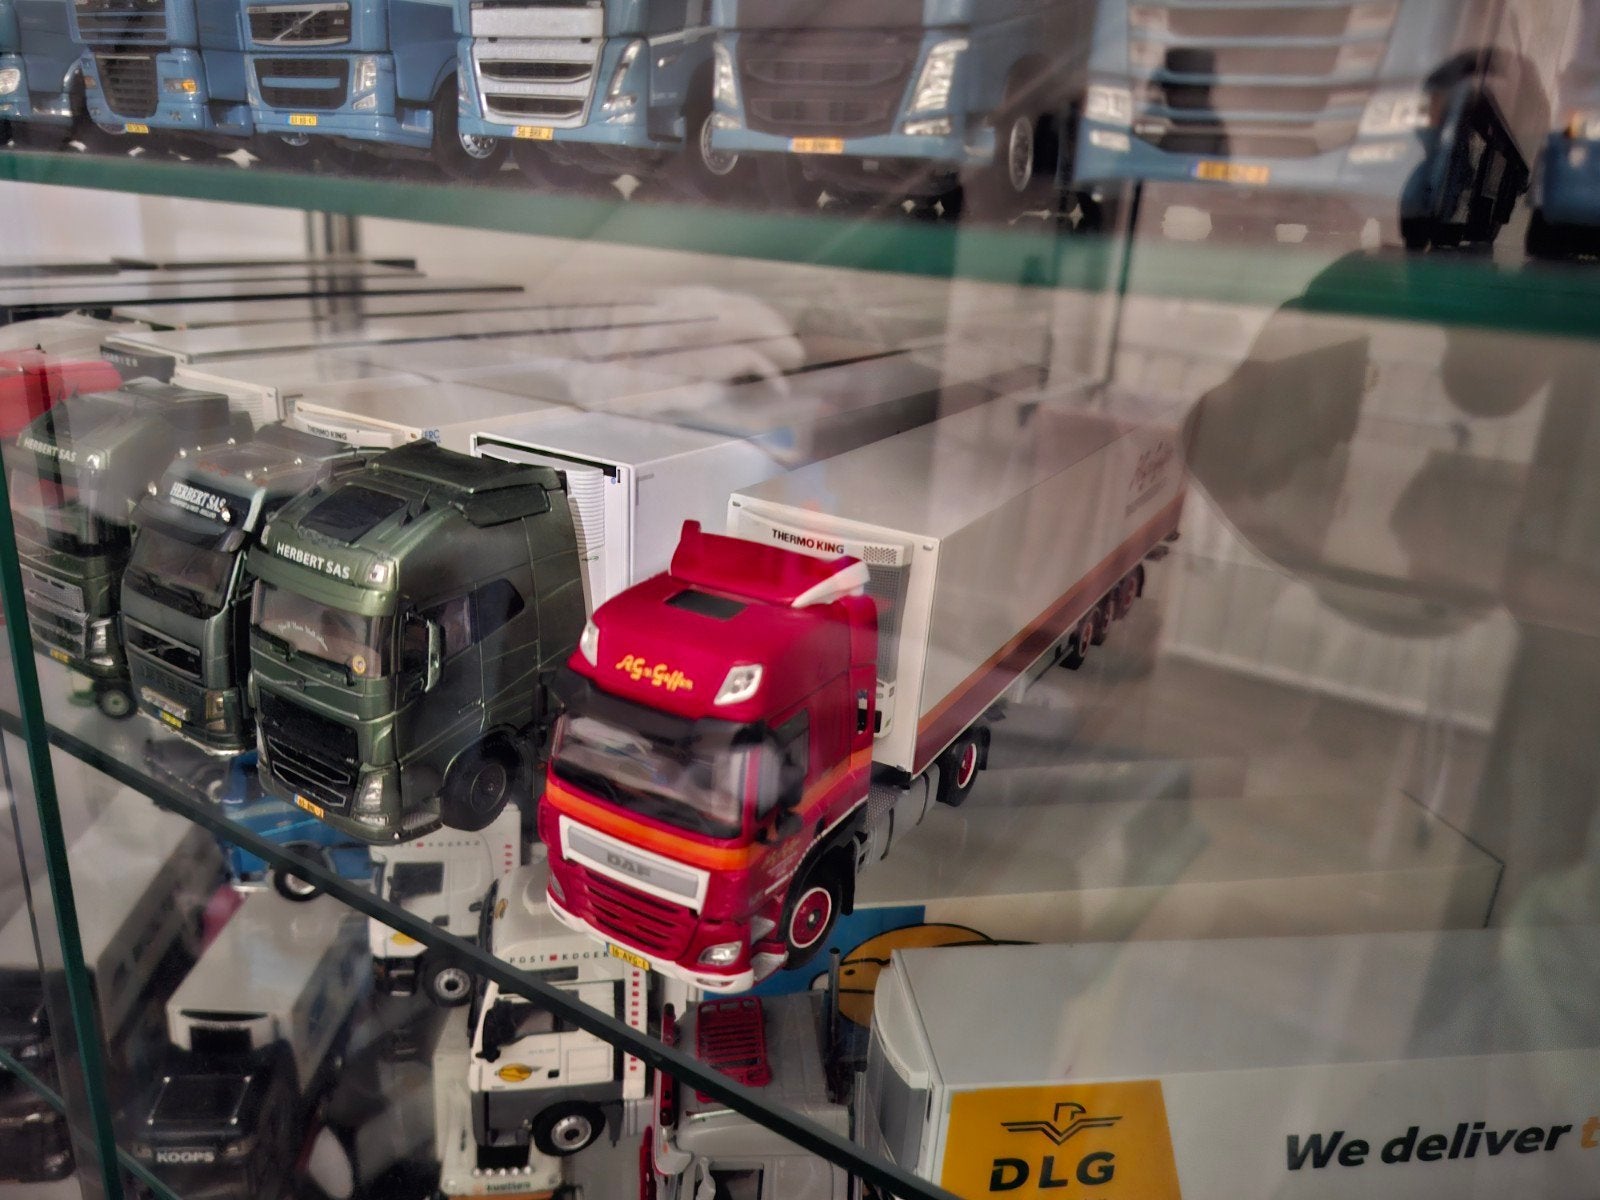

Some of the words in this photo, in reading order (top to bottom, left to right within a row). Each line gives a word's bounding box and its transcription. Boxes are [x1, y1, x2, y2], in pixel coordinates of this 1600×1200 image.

[24, 437, 58, 457] HERBERT
[58, 448, 77, 462] SAS
[170, 482, 210, 507] HERBERT
[206, 494, 227, 513] SAS
[772, 528, 815, 549] THERMO
[816, 541, 845, 554] KING
[276, 541, 325, 571] HERBERT
[325, 560, 351, 580] SAS
[509, 955, 545, 964] POST
[156, 1151, 215, 1163] KOOPS
[1286, 1130, 1370, 1171] We
[1380, 1121, 1573, 1165] deliver
[989, 1151, 1116, 1192] DLG
